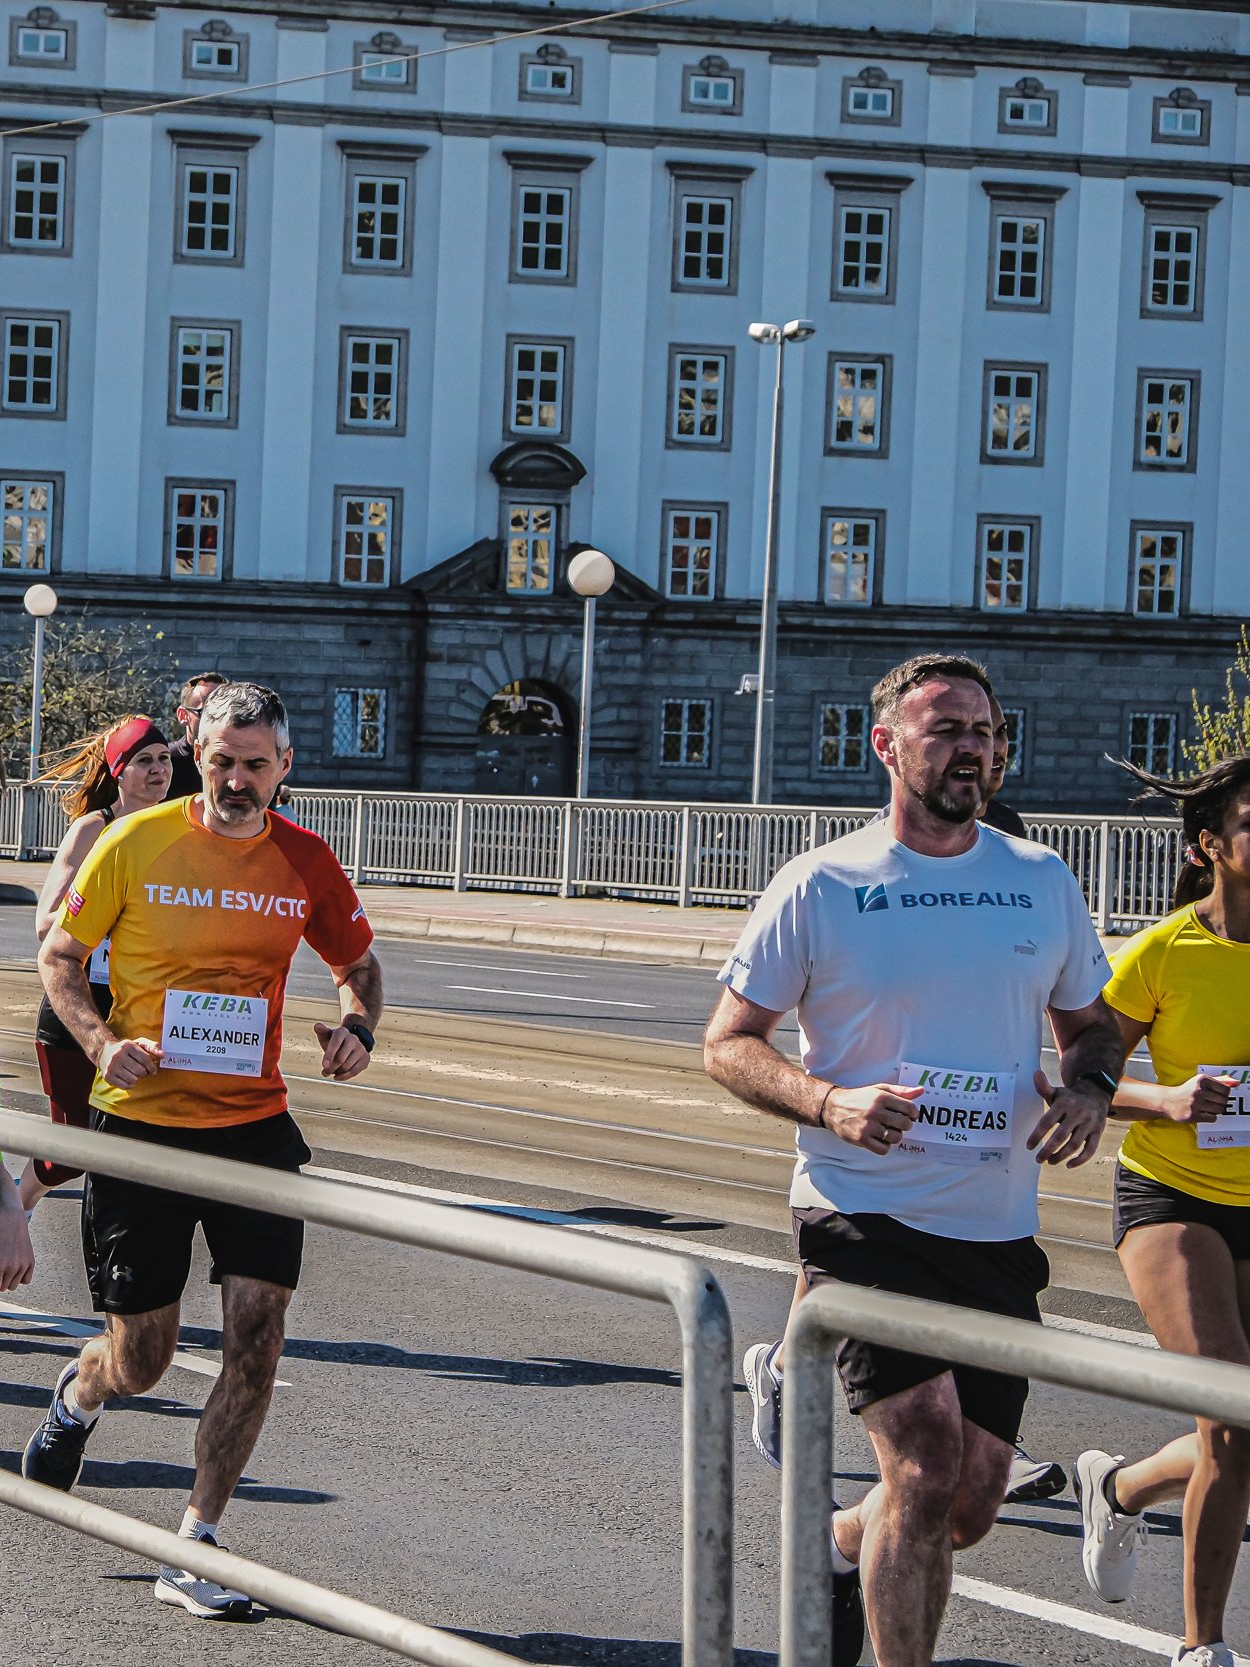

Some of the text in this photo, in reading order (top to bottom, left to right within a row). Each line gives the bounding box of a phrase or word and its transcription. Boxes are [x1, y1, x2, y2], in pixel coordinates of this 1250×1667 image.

[143, 884, 307, 919] TEAM ESV/CTC
[900, 892, 1034, 910] BOREALIS
[182, 994, 253, 1015] KEBA
[168, 1025, 261, 1047] ALEXANDER
[205, 1045, 227, 1055] 2209
[917, 1069, 999, 1094] KEBA
[912, 1103, 1008, 1131] NDREAS
[944, 1131, 968, 1143] 1424
